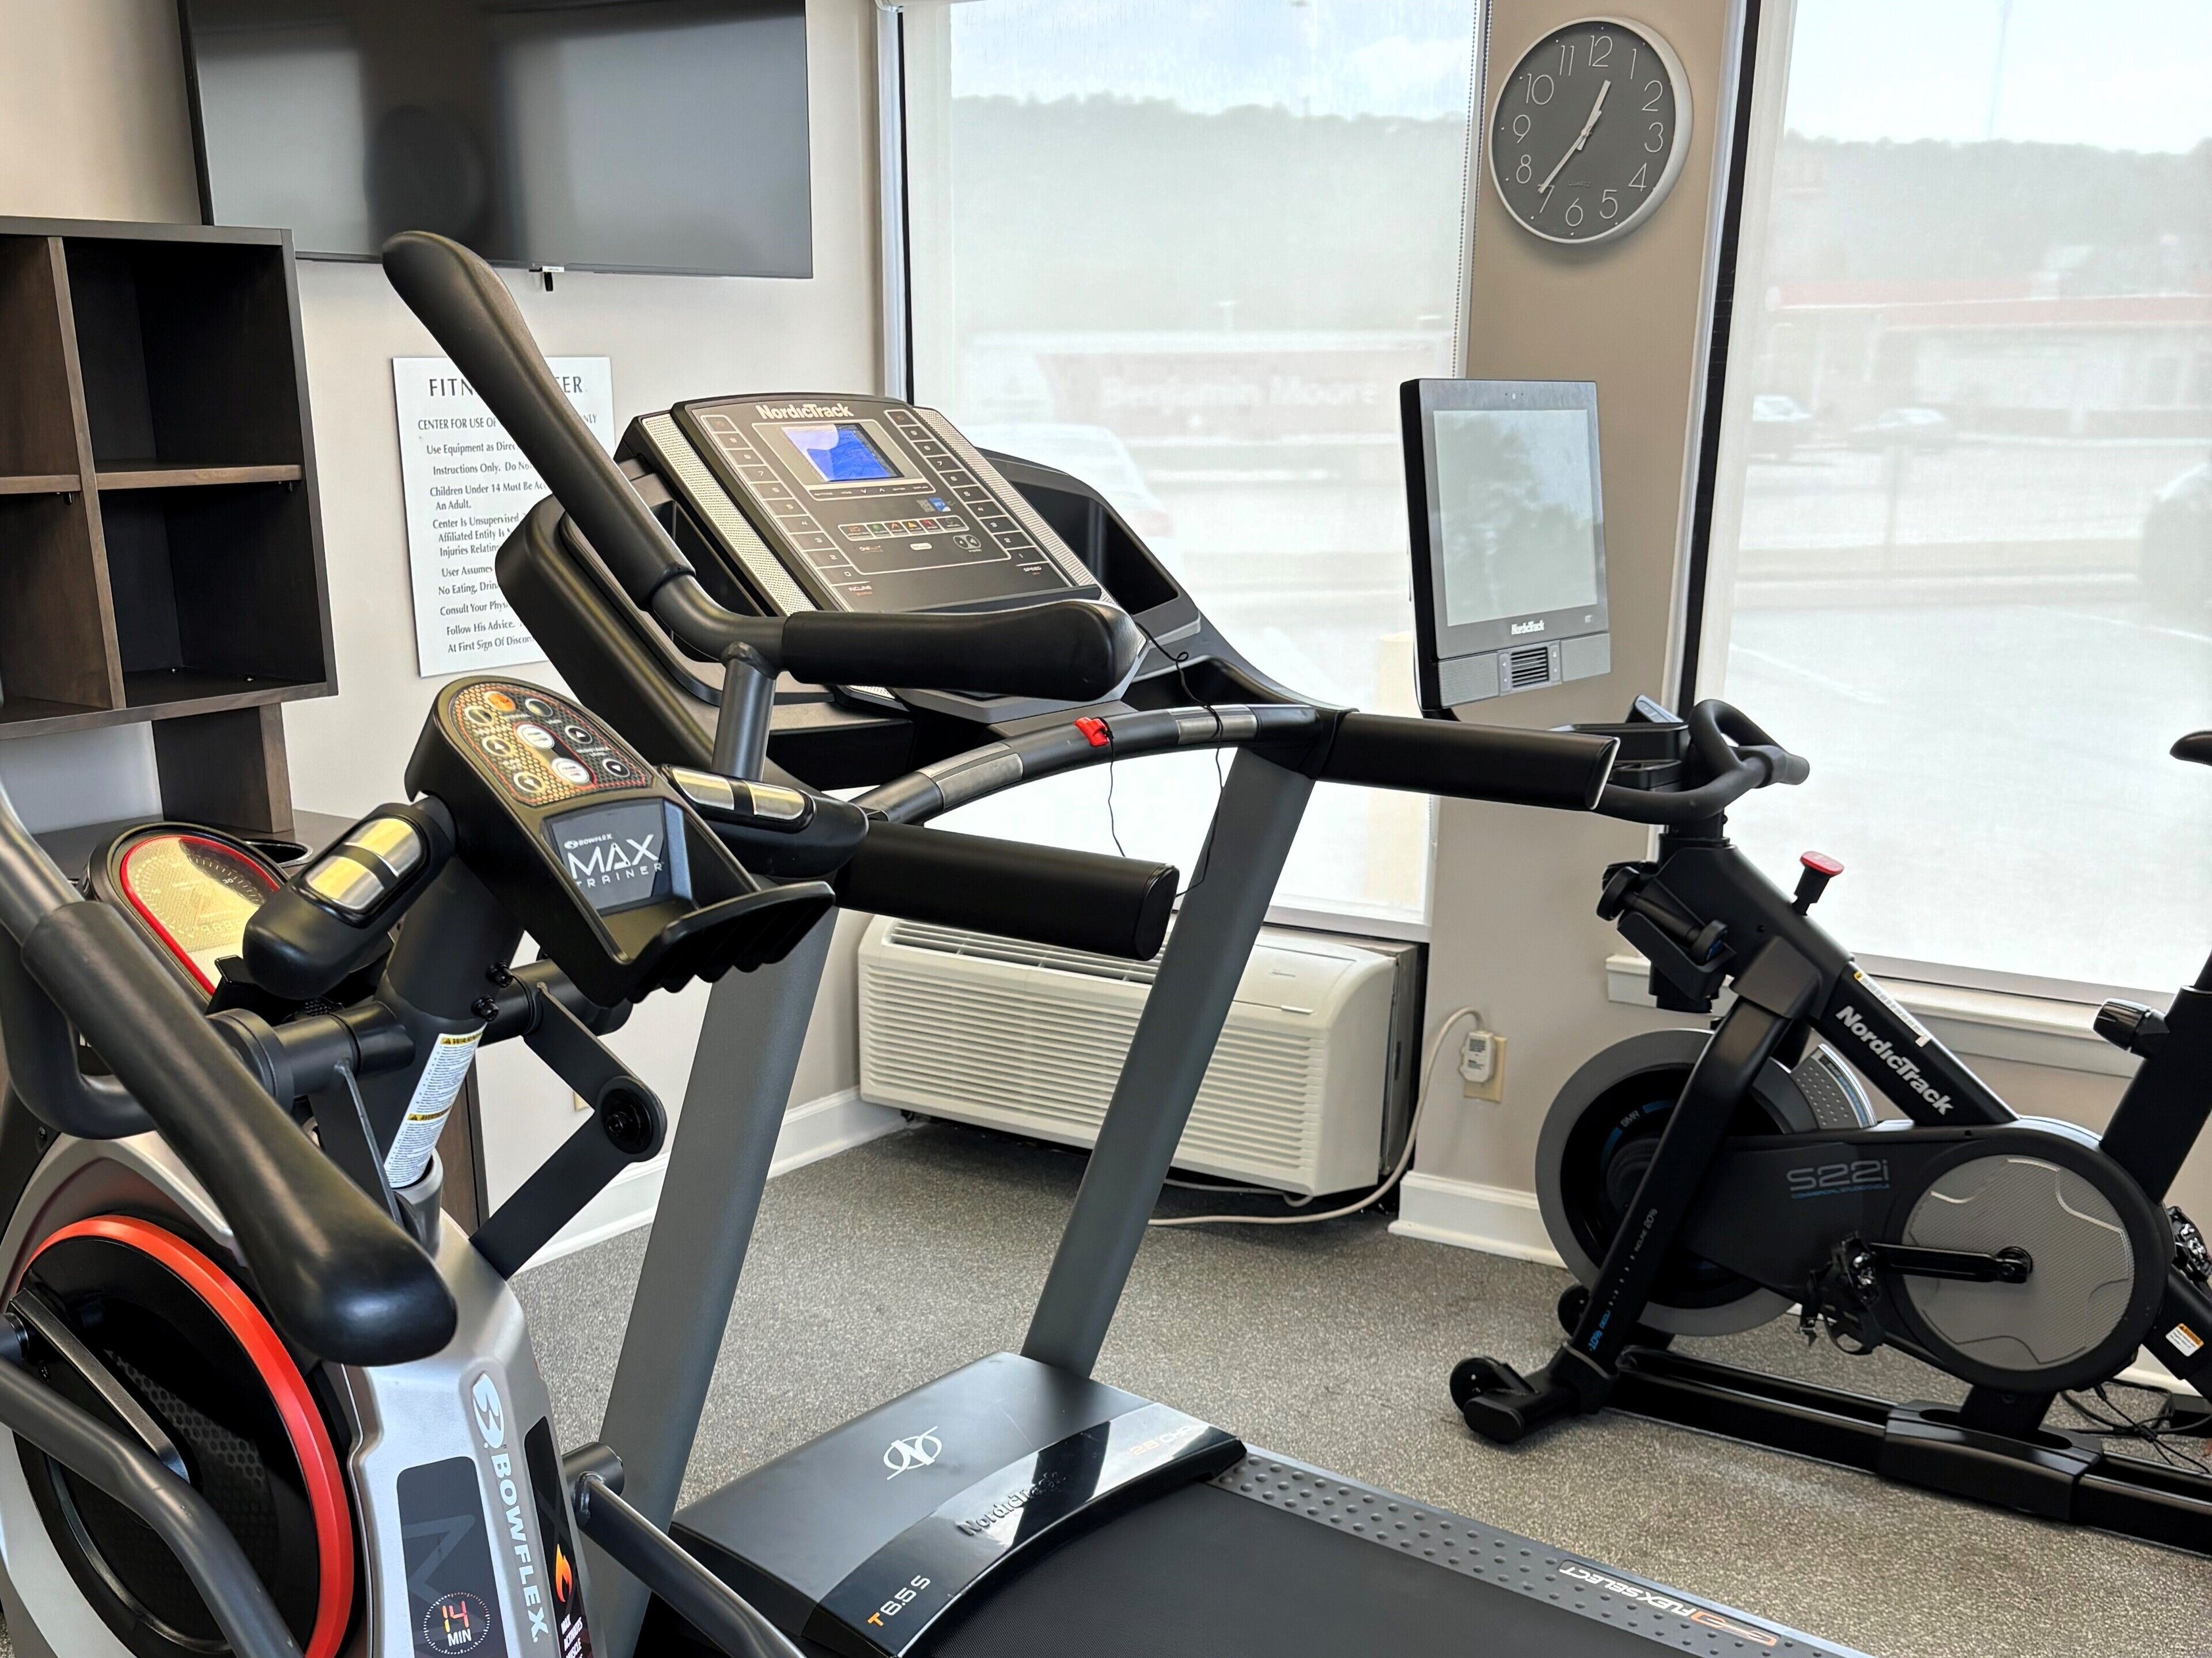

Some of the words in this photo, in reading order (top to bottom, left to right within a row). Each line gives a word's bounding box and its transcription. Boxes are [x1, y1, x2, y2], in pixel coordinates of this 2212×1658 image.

[1559, 45, 1574, 76] 11
[1589, 35, 1613, 67] 12
[1630, 48, 1637, 79] 1
[1526, 74, 1554, 105] 10
[1642, 80, 1664, 112] 2
[1513, 114, 1531, 144] 9
[1645, 122, 1664, 153] 3
[1516, 154, 1532, 184] 8
[1628, 162, 1647, 192] 4
[1537, 184, 1555, 214] 7
[1599, 189, 1618, 219] 5
[1565, 198, 1584, 227] 6
[429, 378, 474, 397] FITN
[418, 419, 449, 430] CENTER
[451, 418, 467, 428] FOR
[469, 417, 484, 428] USE
[755, 403, 854, 419] NordicTrack
[427, 445, 441, 454] Use
[444, 442, 484, 456] Equipment
[433, 464, 478, 475] Instructions
[480, 462, 501, 474] Only.
[505, 462, 516, 471] Do
[518, 461, 531, 470] No
[430, 486, 463, 496] Children
[465, 484, 488, 494] Under
[491, 484, 500, 492] 14
[503, 482, 521, 491] Must
[523, 481, 532, 490] Be
[435, 502, 446, 510] An
[448, 499, 471, 510] Adult.
[433, 519, 458, 529] Center
[461, 518, 467, 527] Is
[469, 513, 519, 526] Unsupervised
[438, 530, 473, 542] Affiliated
[475, 528, 496, 540] Entity
[499, 528, 505, 537] Is
[440, 545, 468, 559] Injuries
[442, 568, 459, 577] User
[461, 566, 493, 575] Assumes
[438, 586, 450, 595] No
[440, 604, 468, 616] Consult
[470, 603, 487, 612] Your
[446, 625, 471, 636] Follow
[474, 622, 486, 632] His
[448, 644, 456, 653] At
[459, 642, 475, 652] First
[477, 639, 493, 651] Sign
[495, 637, 505, 647] Of
[578, 833, 613, 846] BOWFLEX
[567, 834, 660, 879] MAX
[576, 863, 662, 888] TRAINER
[1836, 1006, 1953, 1115] NordicTrack
[1787, 1159, 1889, 1192] S22i
[491, 1453, 548, 1636] BOWFLEX
[442, 1600, 470, 1633] 14
[447, 1629, 472, 1647] MIN
